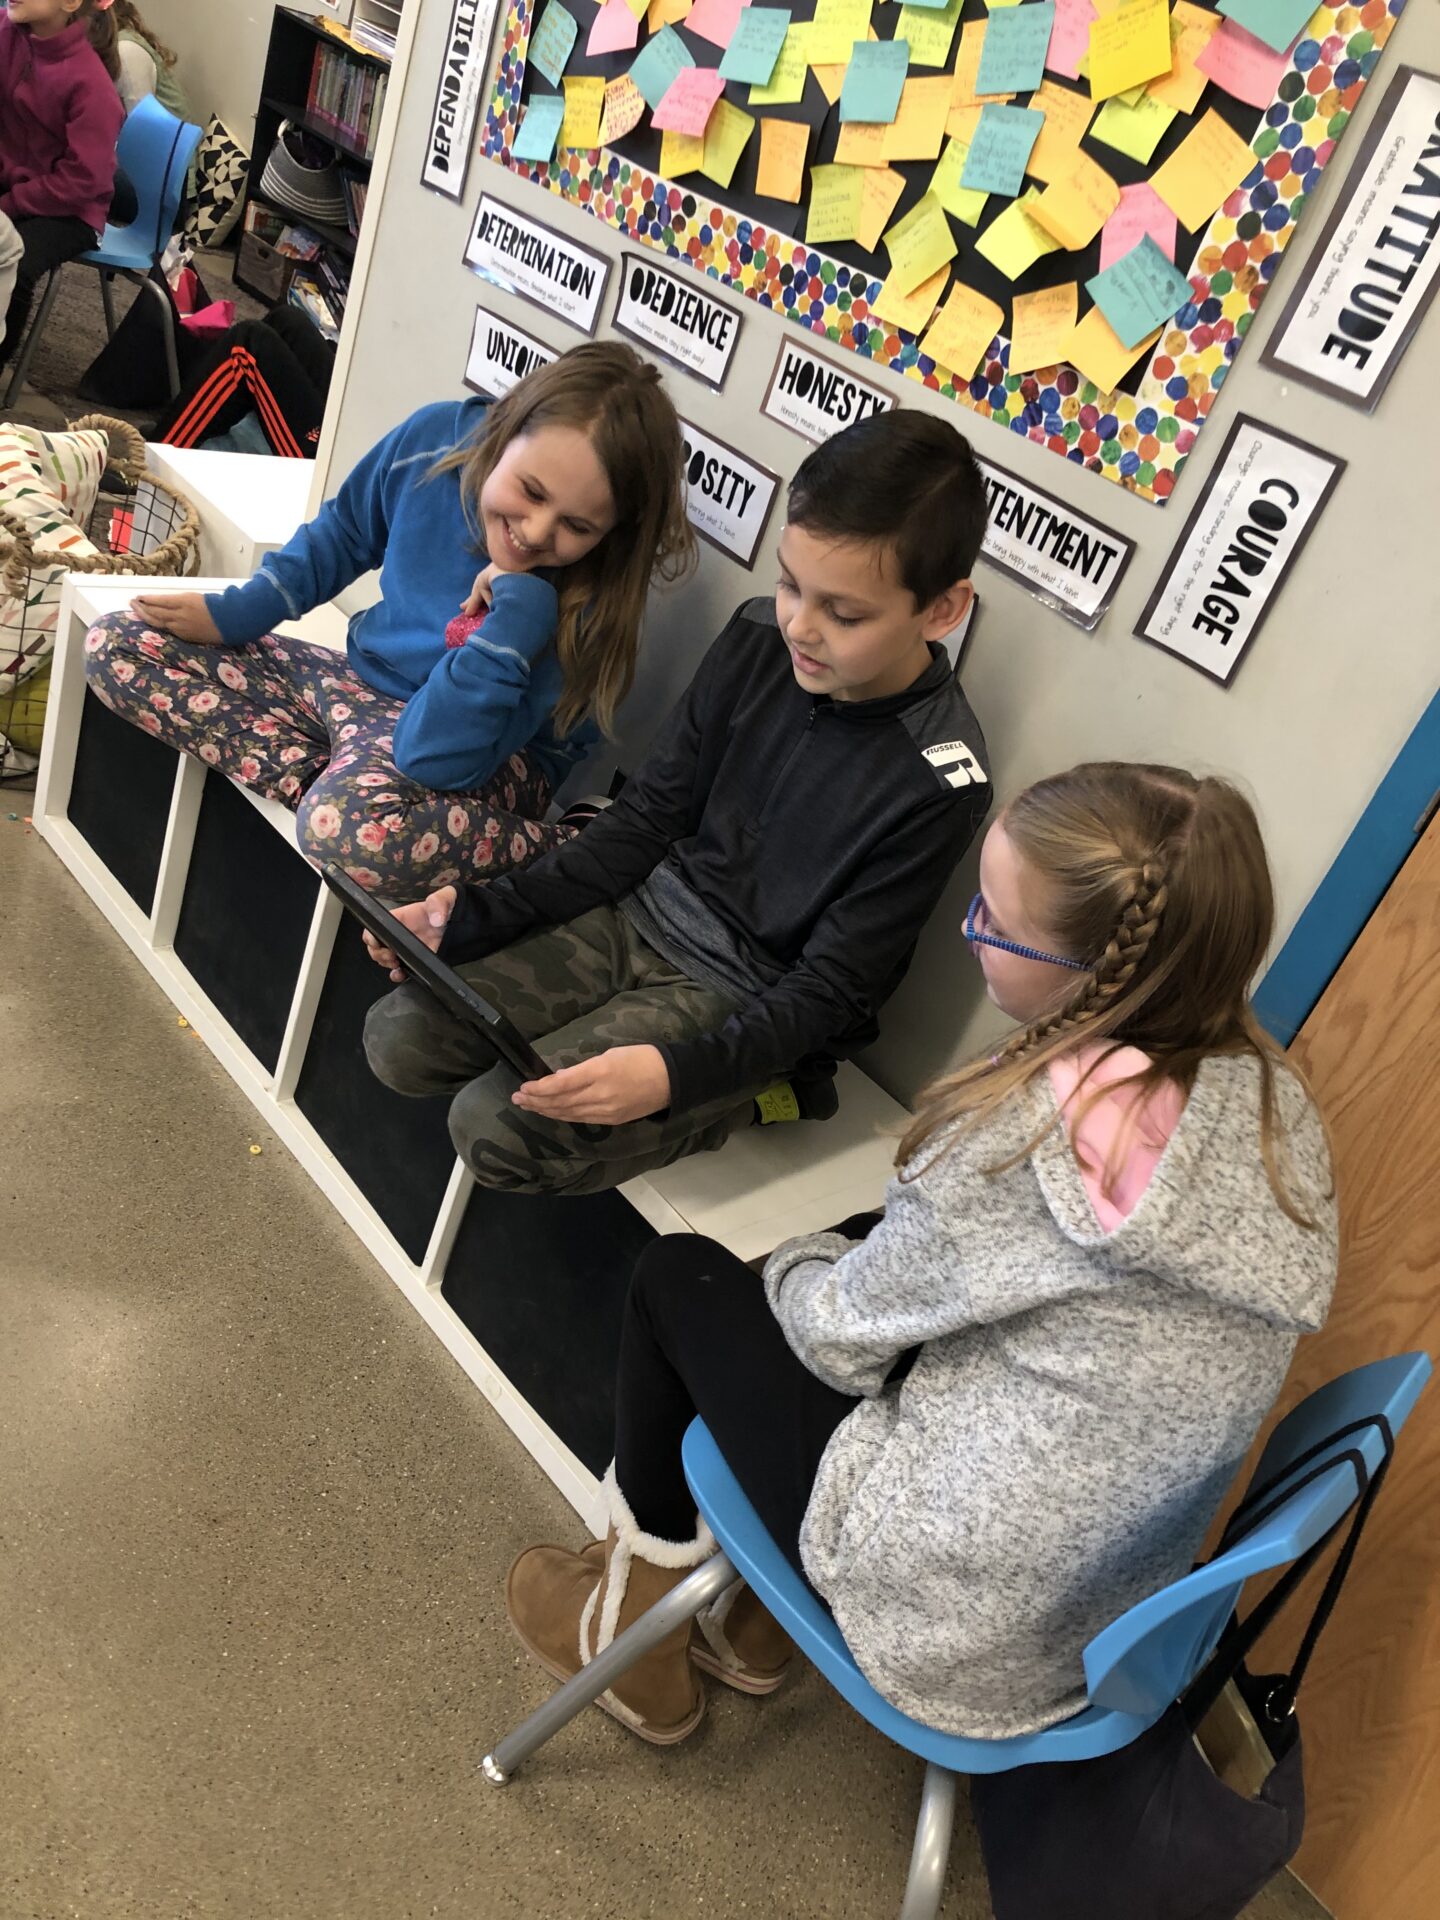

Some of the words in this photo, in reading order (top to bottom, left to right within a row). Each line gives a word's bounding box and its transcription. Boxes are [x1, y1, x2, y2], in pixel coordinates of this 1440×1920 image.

[1374, 135, 1406, 186] Gratitude
[1355, 190, 1377, 226] means
[477, 210, 596, 300] DETERMINATION
[1321, 110, 1440, 370] ATITUDE
[1332, 229, 1358, 264] saying
[1319, 267, 1340, 296] thank
[630, 267, 733, 352] OBEDIENCE
[486, 327, 550, 379] UNIQU
[1239, 439, 1262, 477] Courage
[1224, 480, 1241, 507] means
[984, 477, 1118, 585] TENTMENT
[1202, 509, 1226, 545] standing
[1009, 550, 1027, 569] happy
[1027, 563, 1040, 576] with
[1040, 570, 1057, 584] what
[1063, 584, 1079, 600] have
[1192, 478, 1300, 646] COURAGE
[1192, 560, 1203, 575] for
[1183, 577, 1195, 591] the
[926, 742, 964, 756] RUSSELL
